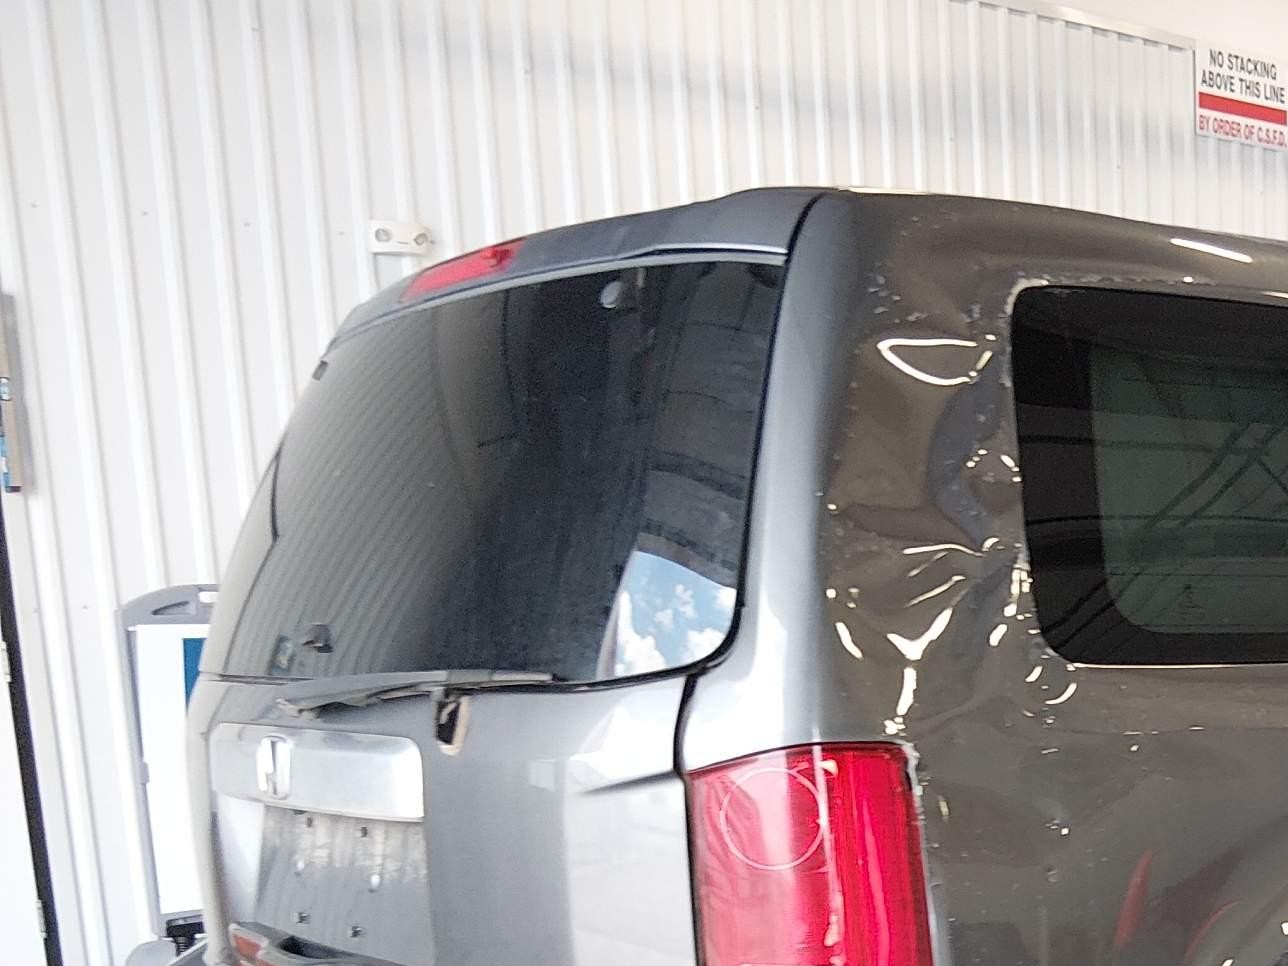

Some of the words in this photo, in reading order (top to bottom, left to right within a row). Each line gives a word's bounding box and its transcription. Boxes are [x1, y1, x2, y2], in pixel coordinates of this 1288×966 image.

[1209, 48, 1224, 68] NO
[1227, 53, 1277, 80] STACKING
[1201, 69, 1235, 93] ABOVE
[1239, 77, 1261, 98] THIS
[1264, 83, 1285, 104] LINE
[1199, 114, 1210, 132] BY
[1213, 117, 1242, 138] ORDER
[1244, 124, 1255, 140] OF
